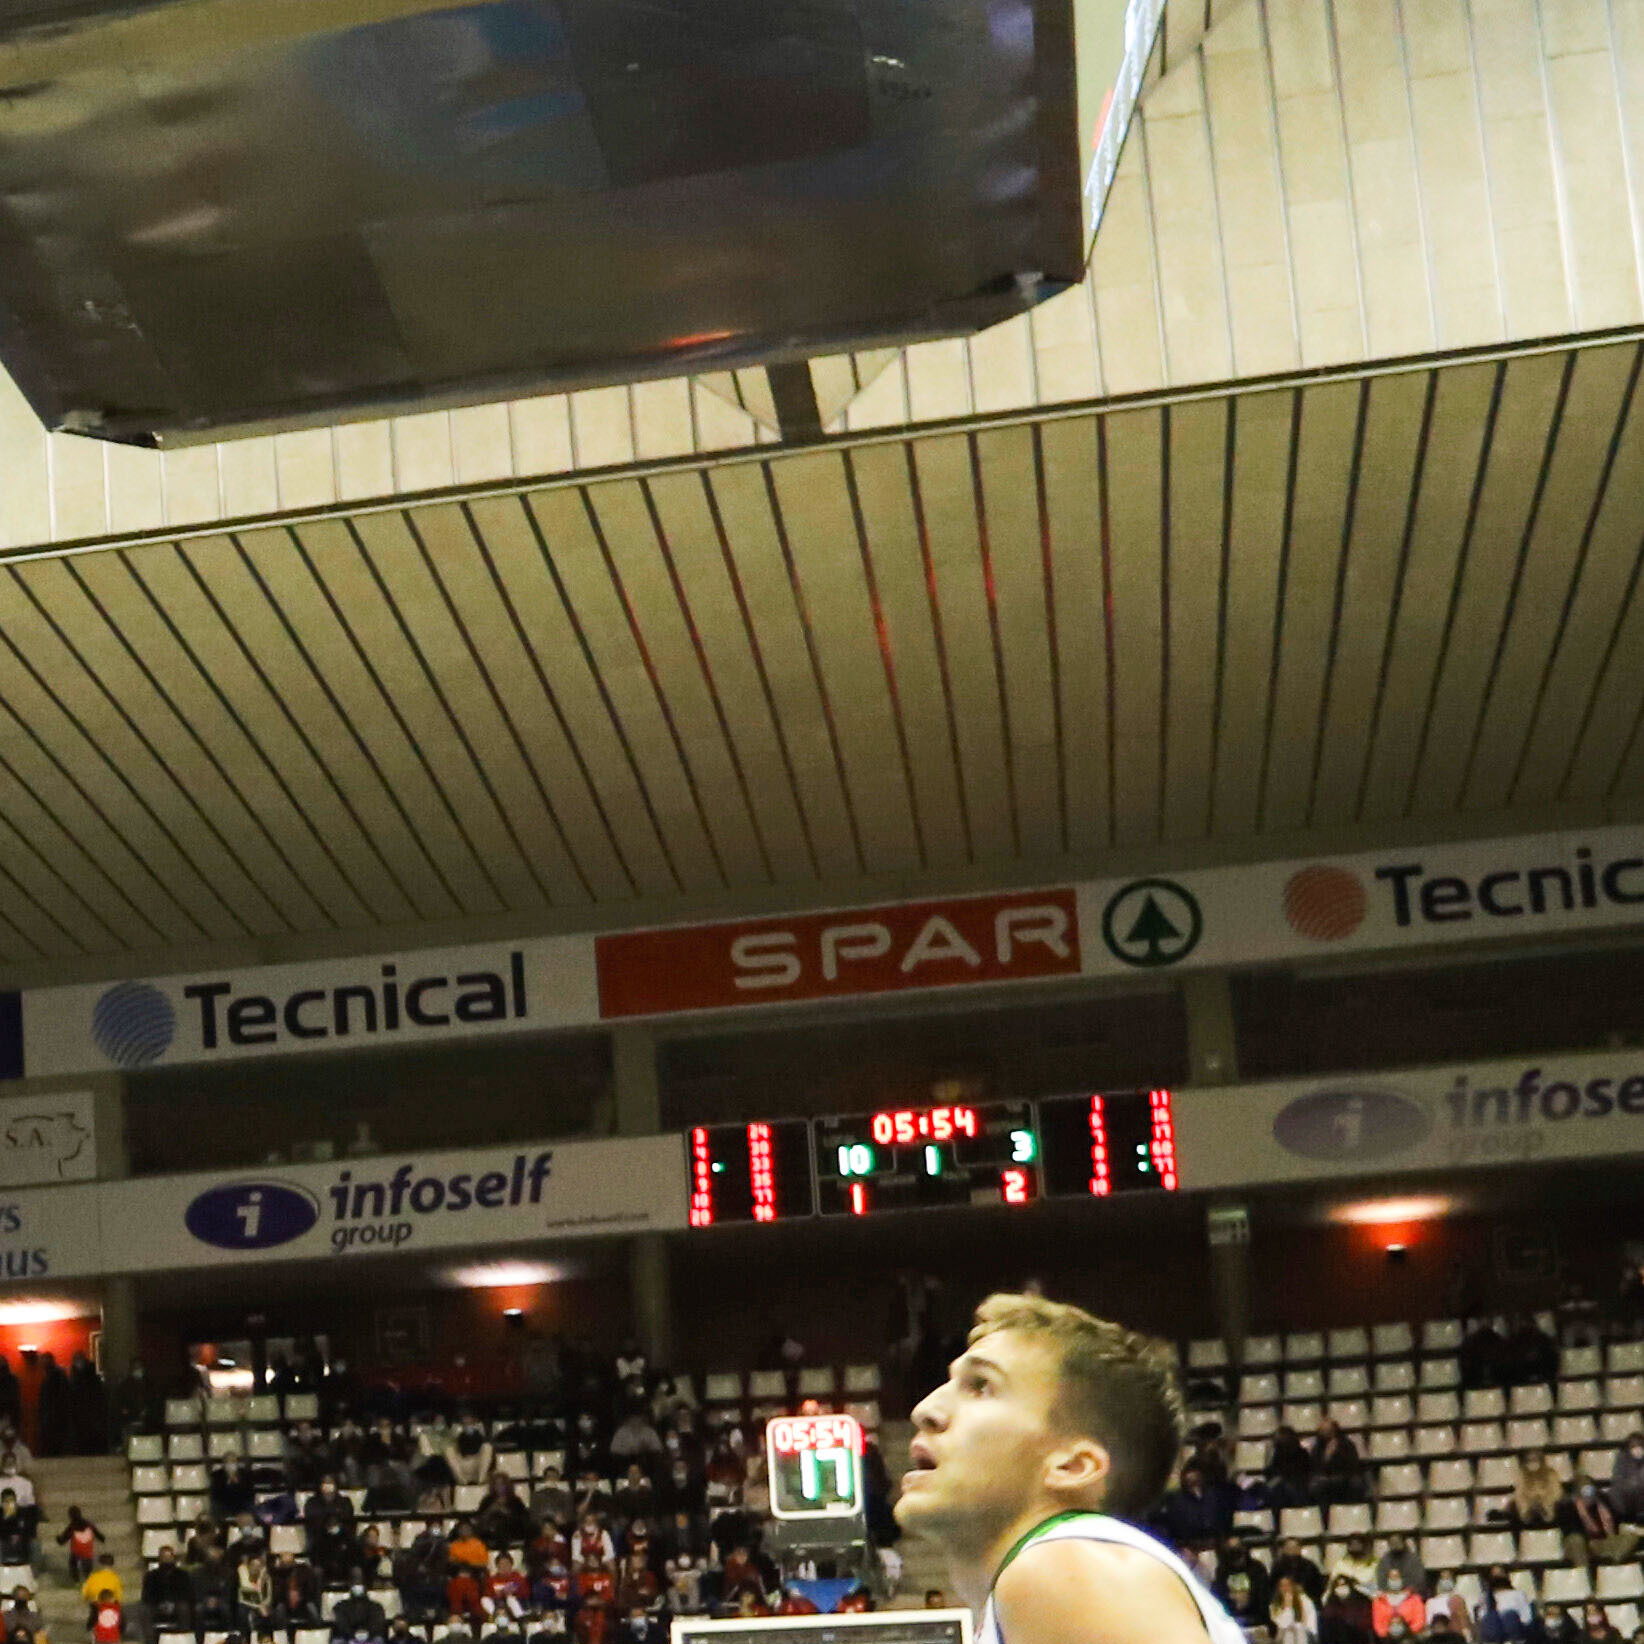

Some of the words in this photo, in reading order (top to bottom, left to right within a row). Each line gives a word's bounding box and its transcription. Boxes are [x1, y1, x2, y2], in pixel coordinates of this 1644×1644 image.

[731, 905, 1073, 989] SPAR
[183, 951, 529, 1050] Tecnical
[870, 1106, 979, 1145] 05:54
[837, 1143, 876, 1176] 10
[924, 1143, 943, 1176] 1
[1010, 1129, 1036, 1163] 3
[328, 1150, 554, 1222] infoself
[849, 1182, 867, 1217] 1
[1001, 1168, 1029, 1204] 2
[330, 1218, 414, 1250] group
[774, 1420, 851, 1451] 05:54
[800, 1448, 853, 1501] 17
